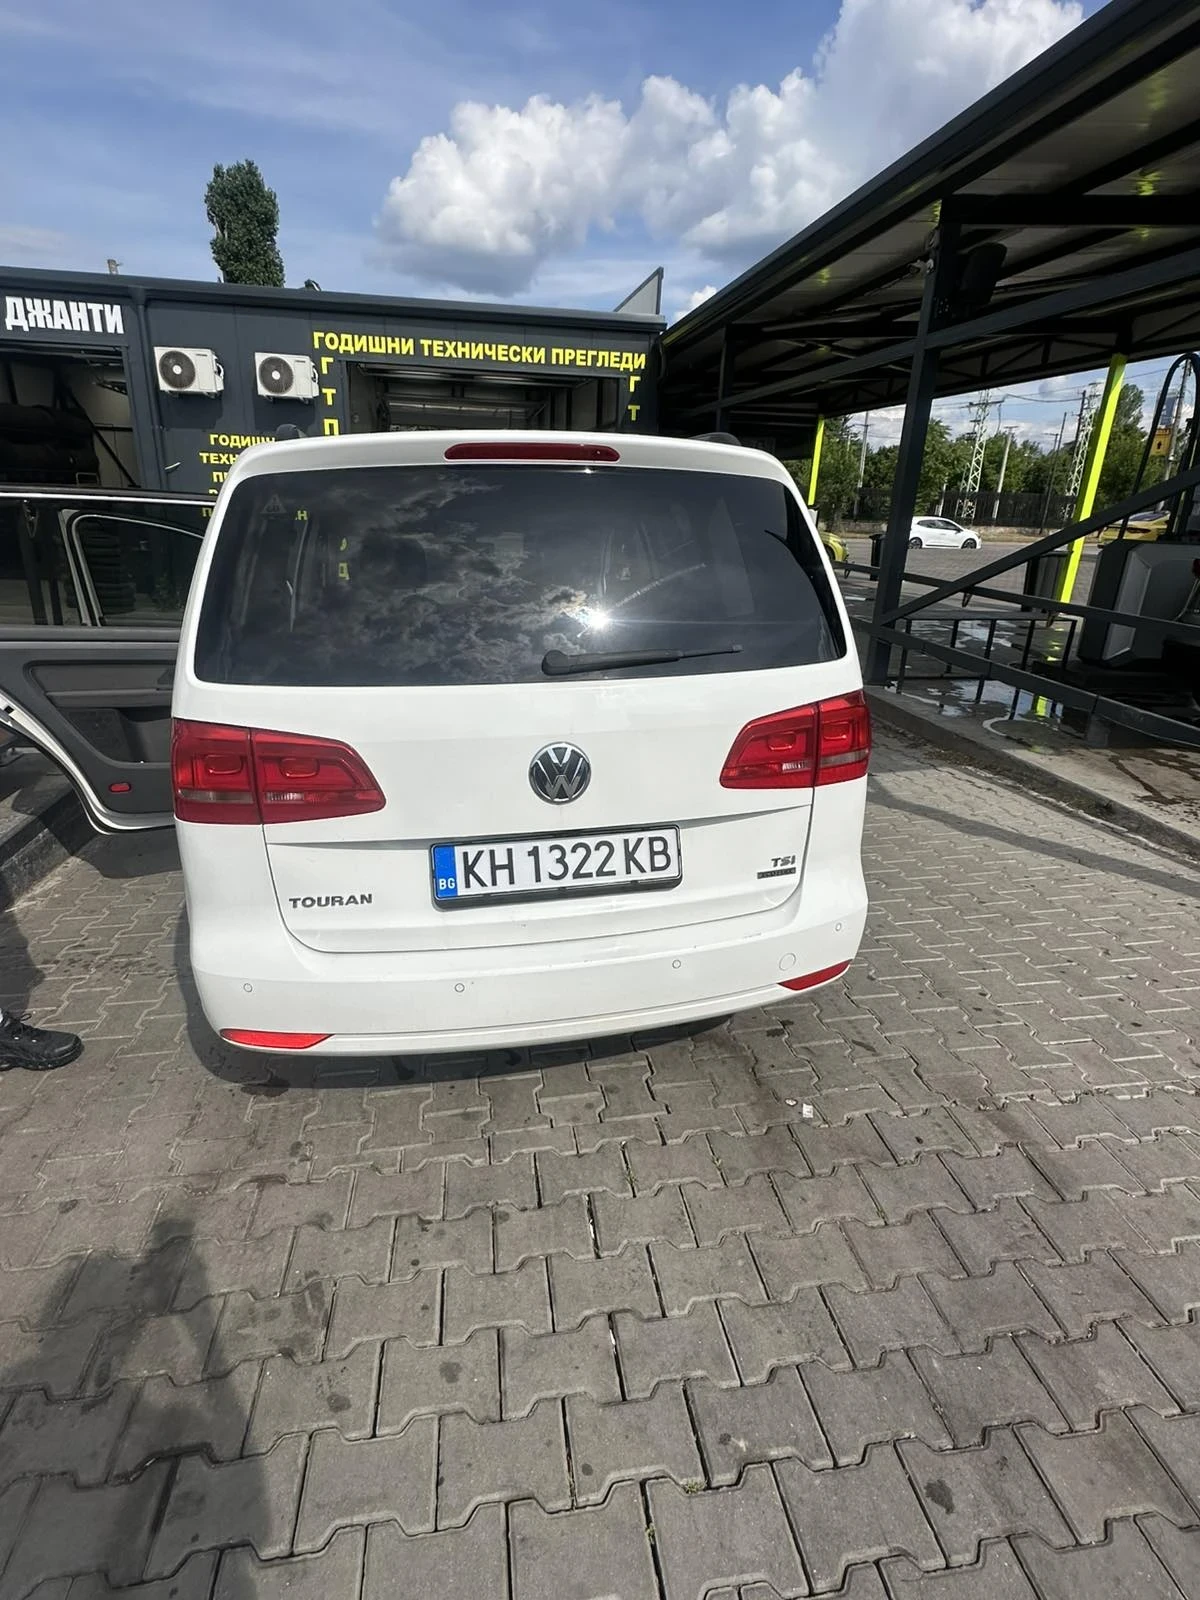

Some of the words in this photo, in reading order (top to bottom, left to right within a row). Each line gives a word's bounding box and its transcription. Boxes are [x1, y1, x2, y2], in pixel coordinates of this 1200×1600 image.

[5, 296, 125, 334] ДЖАНТИ
[313, 331, 414, 356] ГОДИШНИ
[420, 339, 546, 365] ТЕХНИЧЕСКИ
[551, 348, 647, 371] ПРЕГЛЕДИ
[527, 840, 617, 883] 1322
[771, 854, 796, 868] TSI
[439, 878, 456, 890] BG
[288, 893, 373, 909] TOURAN
